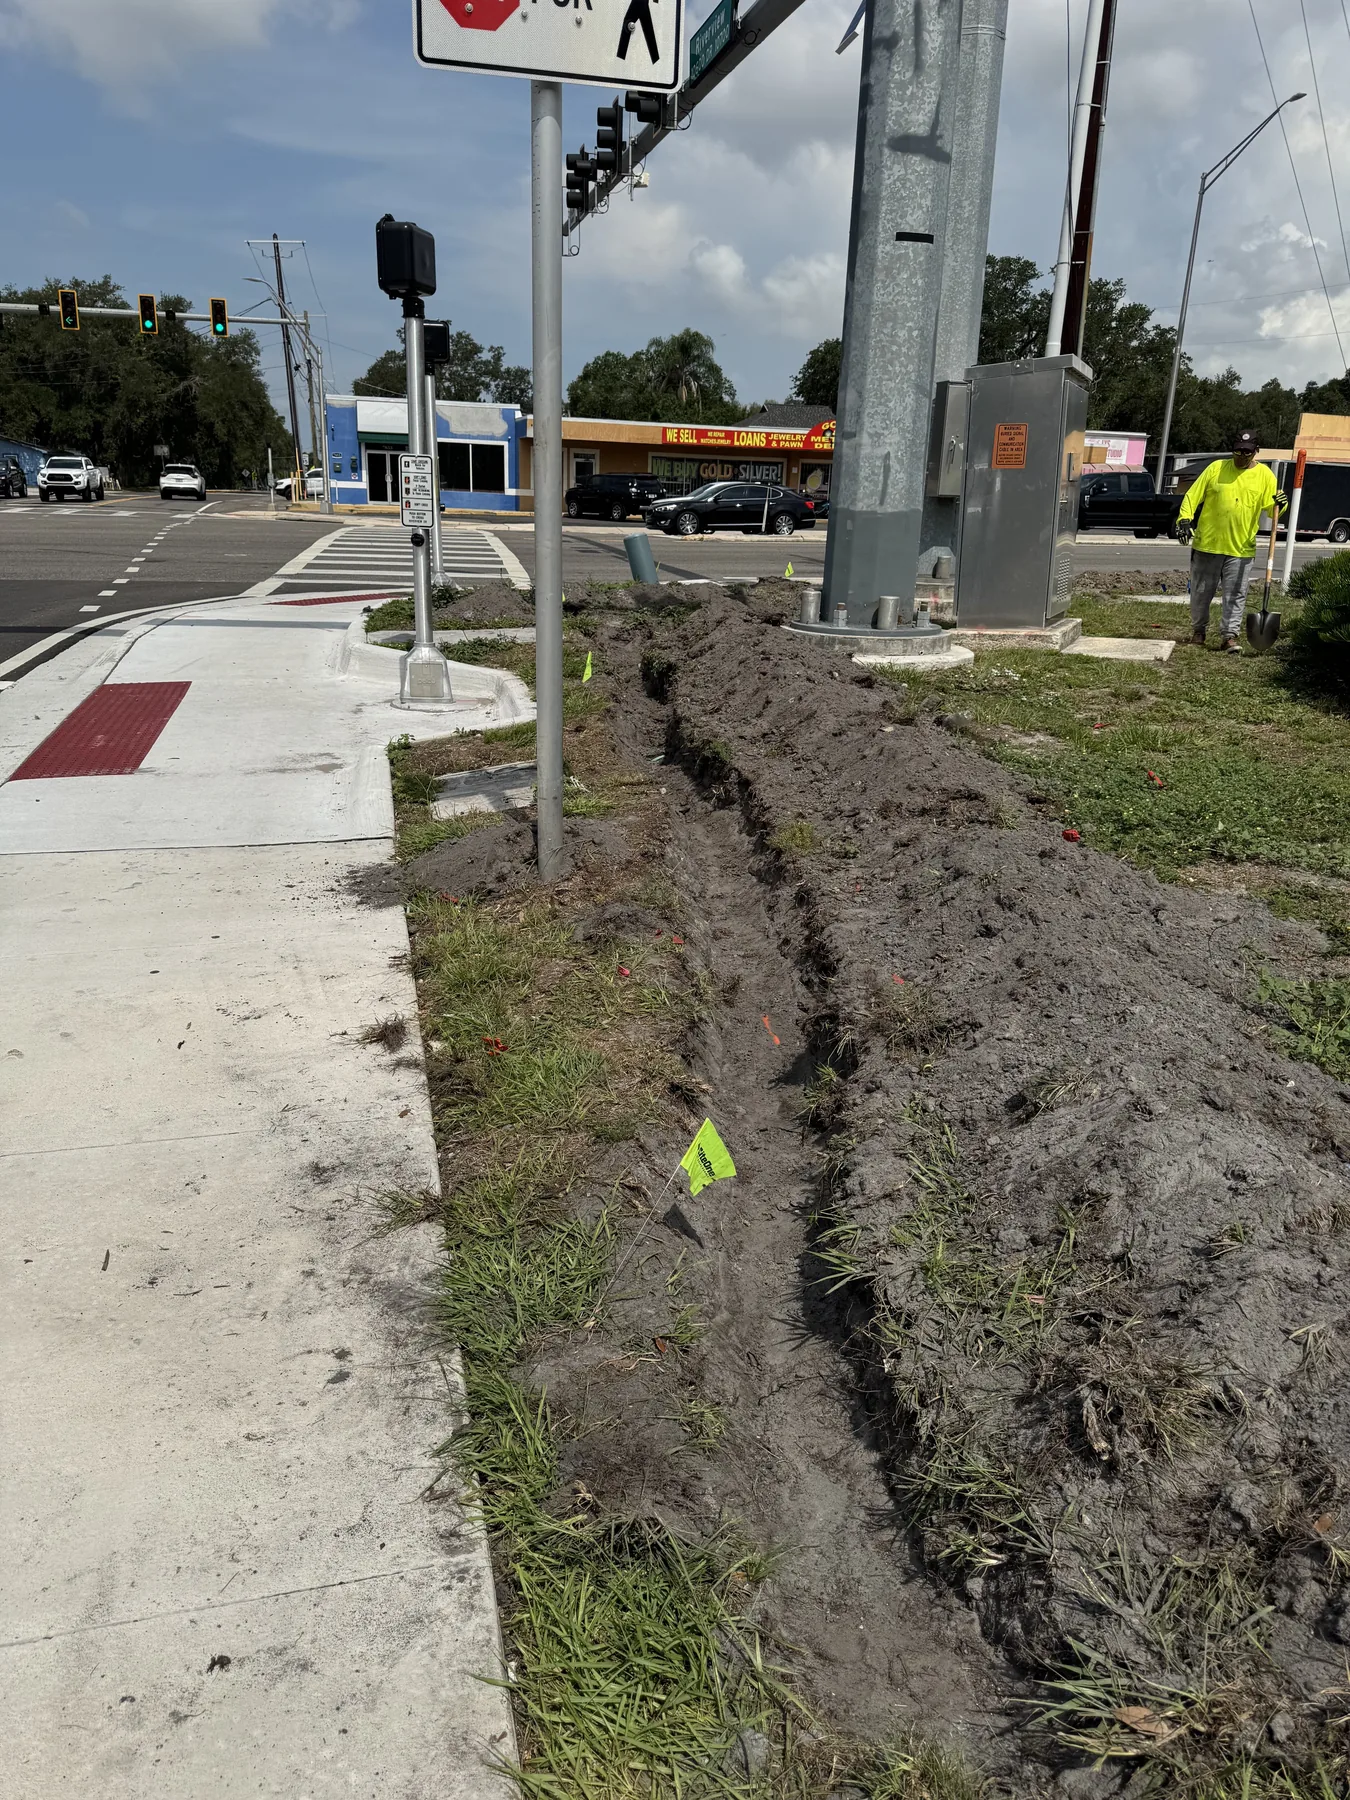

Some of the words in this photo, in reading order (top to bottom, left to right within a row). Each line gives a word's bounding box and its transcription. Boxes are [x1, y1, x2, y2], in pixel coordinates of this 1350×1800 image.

[695, 8, 726, 55] Riverview
[666, 428, 678, 442] WE
[679, 428, 698, 443] SELL
[733, 431, 766, 447] LOANS
[768, 433, 807, 441] JEWELRY
[652, 457, 673, 476] WE
[673, 461, 699, 478] BUY
[700, 462, 734, 480] GOLD
[738, 463, 782, 482] SILVER!
